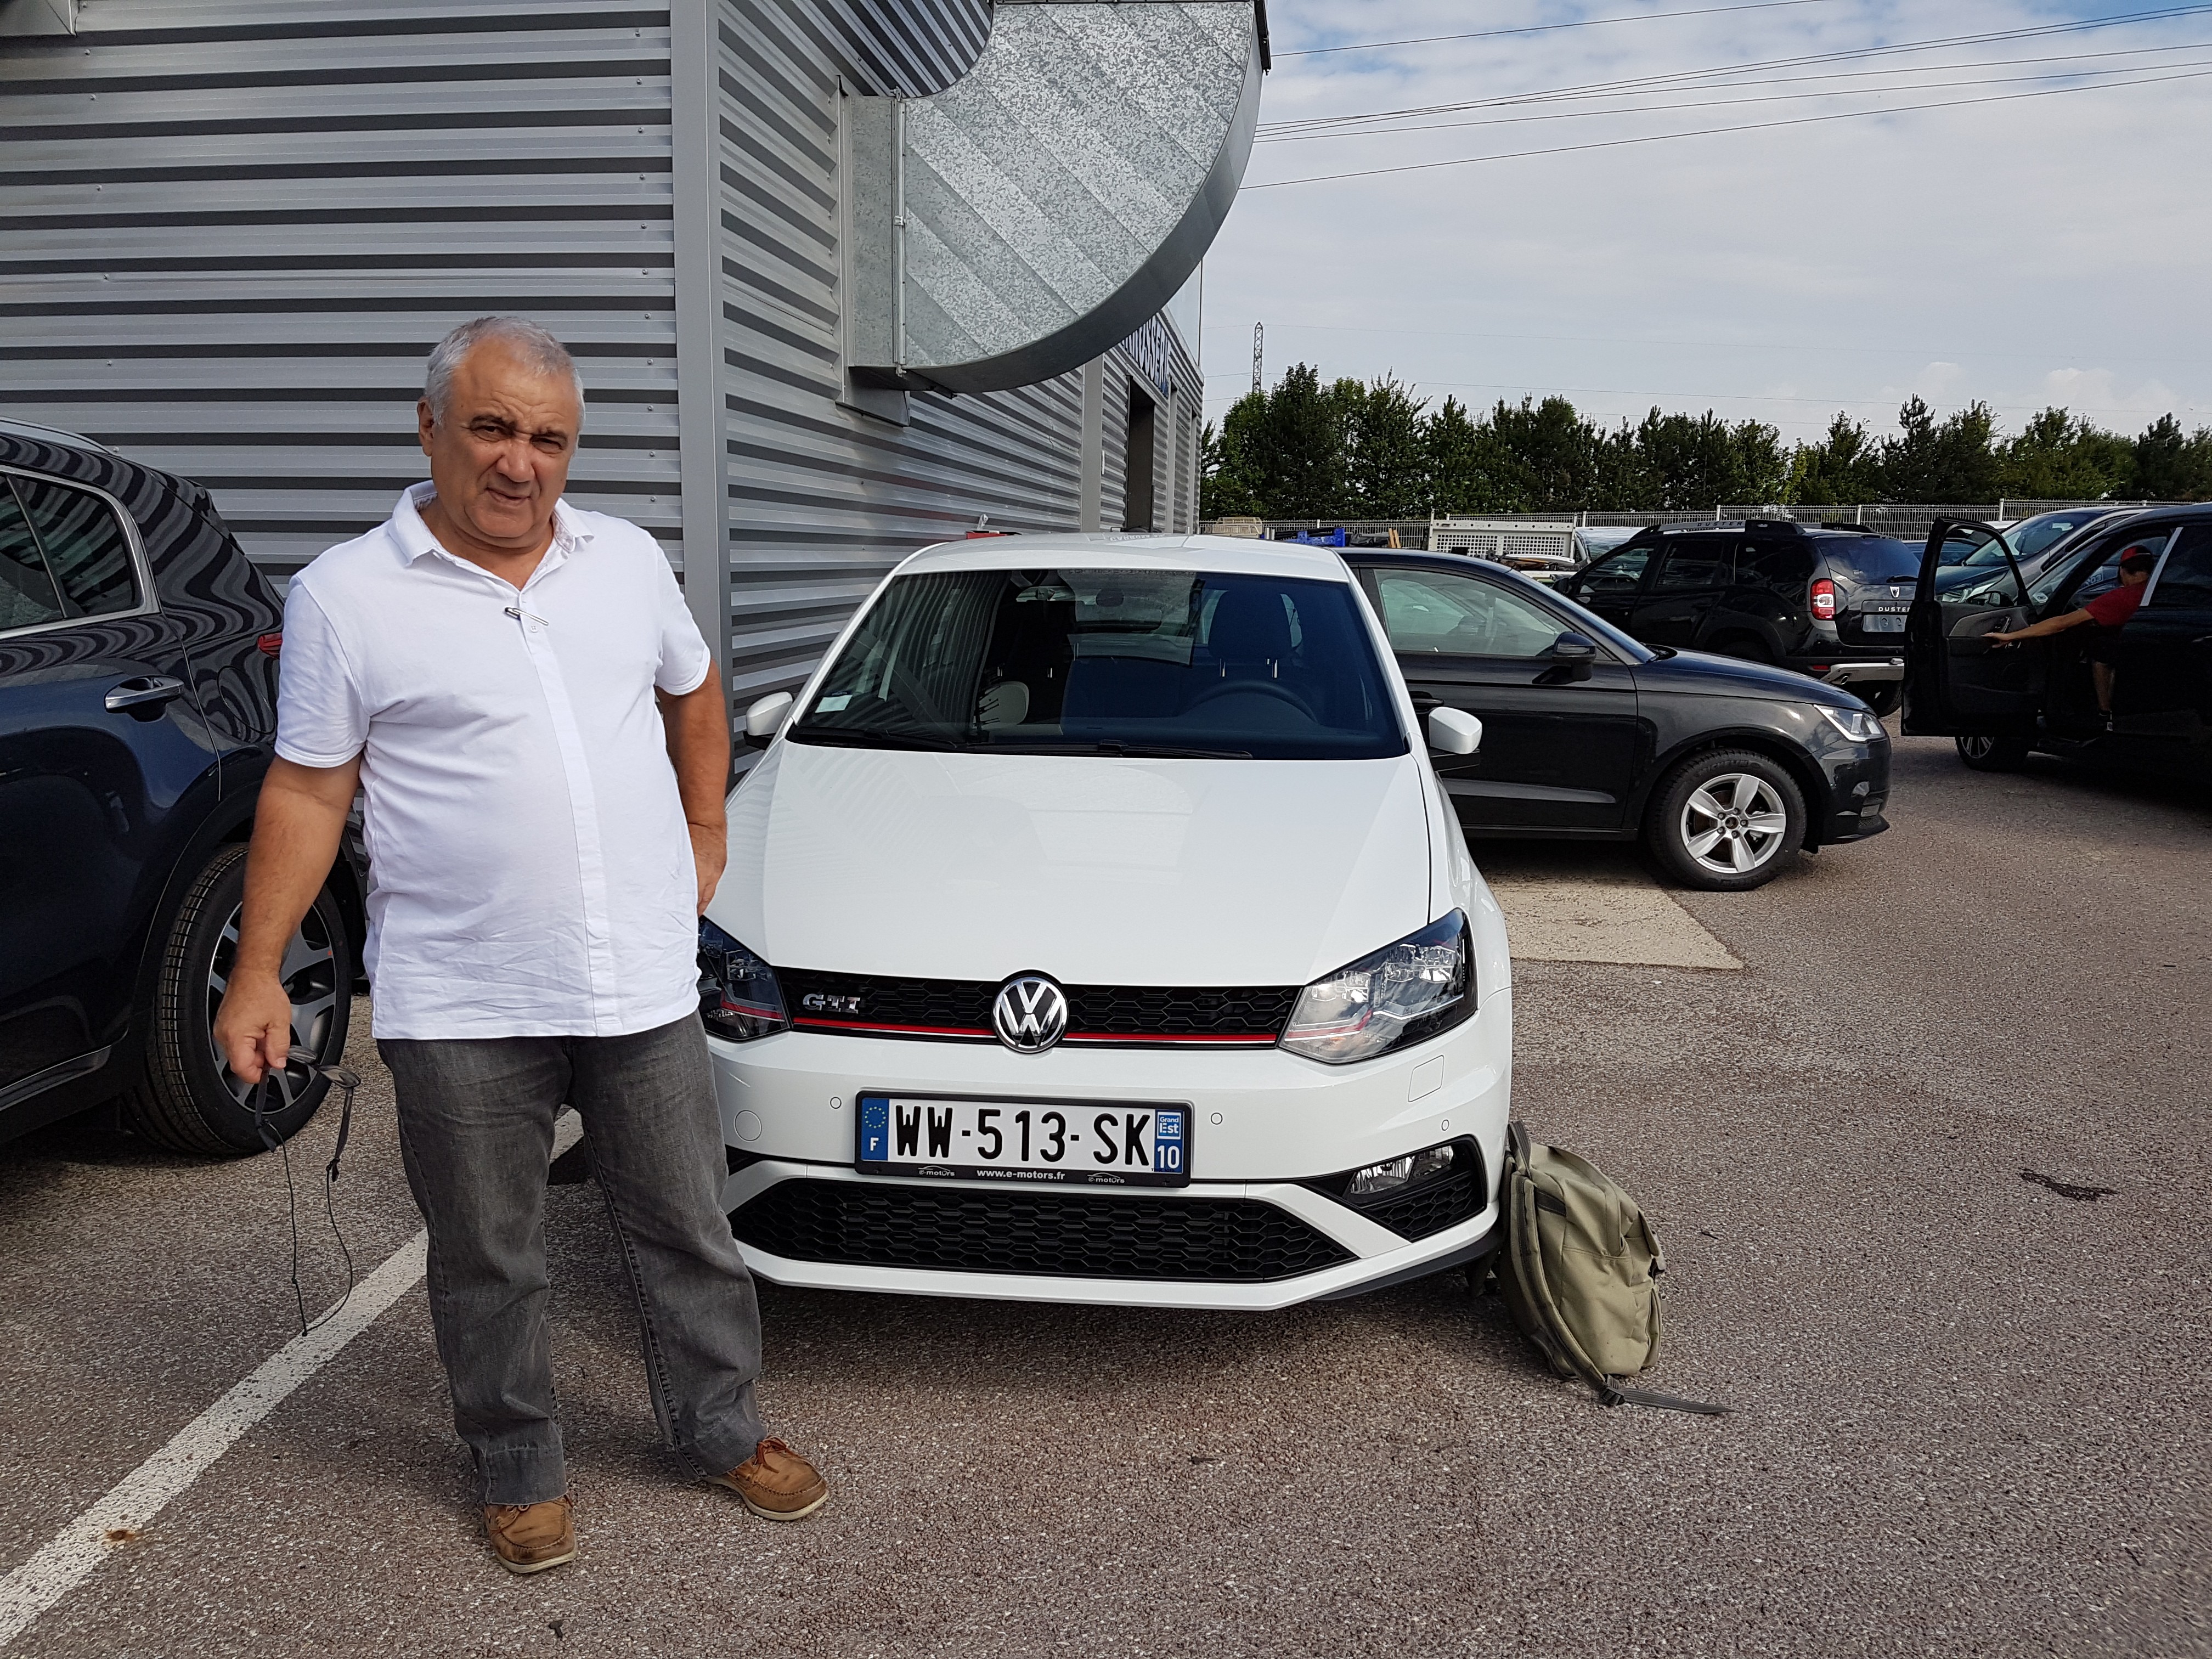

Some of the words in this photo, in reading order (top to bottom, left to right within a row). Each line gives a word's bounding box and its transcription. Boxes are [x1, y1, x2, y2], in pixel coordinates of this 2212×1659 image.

[803, 994, 861, 1014] GTI
[896, 1105, 1150, 1166] WW-513-SK
[1159, 1122, 1179, 1134] Est
[870, 1137, 879, 1152] F
[1157, 1145, 1180, 1169] 10
[977, 1169, 1065, 1180] www.e-motors.fr
